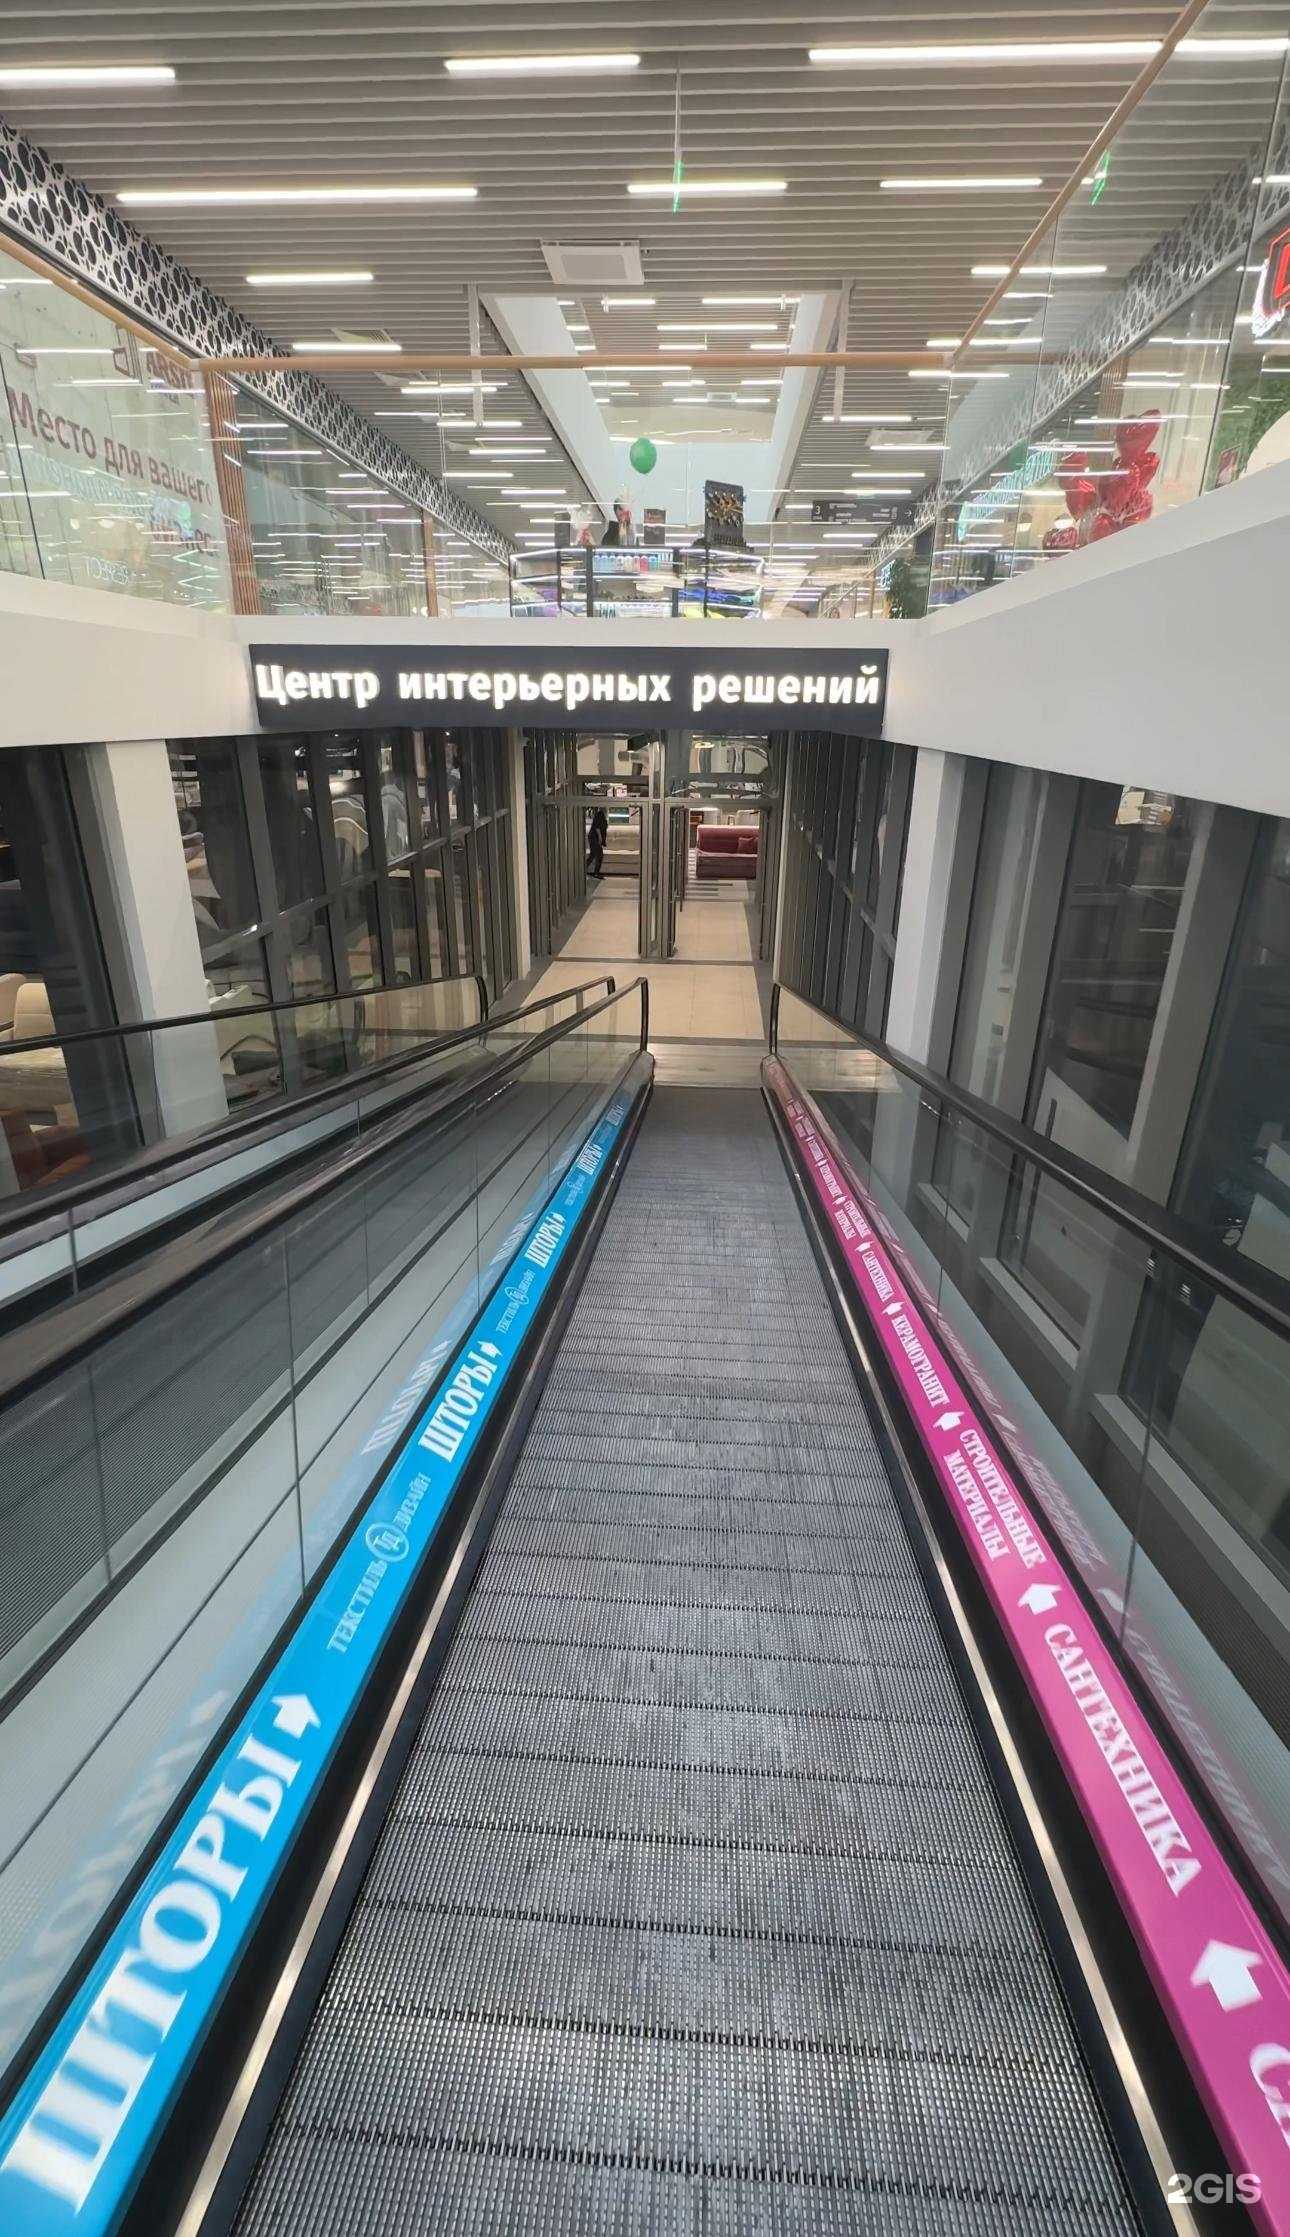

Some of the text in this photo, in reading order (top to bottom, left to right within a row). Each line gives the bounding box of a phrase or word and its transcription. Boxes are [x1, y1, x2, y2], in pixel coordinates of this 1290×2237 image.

[7, 386, 97, 459] Место
[104, 437, 144, 478] для
[255, 664, 880, 712] Центр интерьерных решений
[418, 1351, 498, 1463] ШТОРЫ
[891, 1314, 950, 1408] КЕРАМОГРАНИТ
[943, 1449, 1010, 1562] МАТЕРИАЛЫ
[960, 1429, 1047, 1569] СТРОИТЕЛЬНЫЕ
[327, 1560, 389, 1653] ТЕКСТИЛЬ
[393, 1472, 432, 1532] ДИЗАЙН
[1044, 1623, 1202, 1896] САНТЕХНИКА
[0, 1733, 302, 2217] ШТОРЫ
